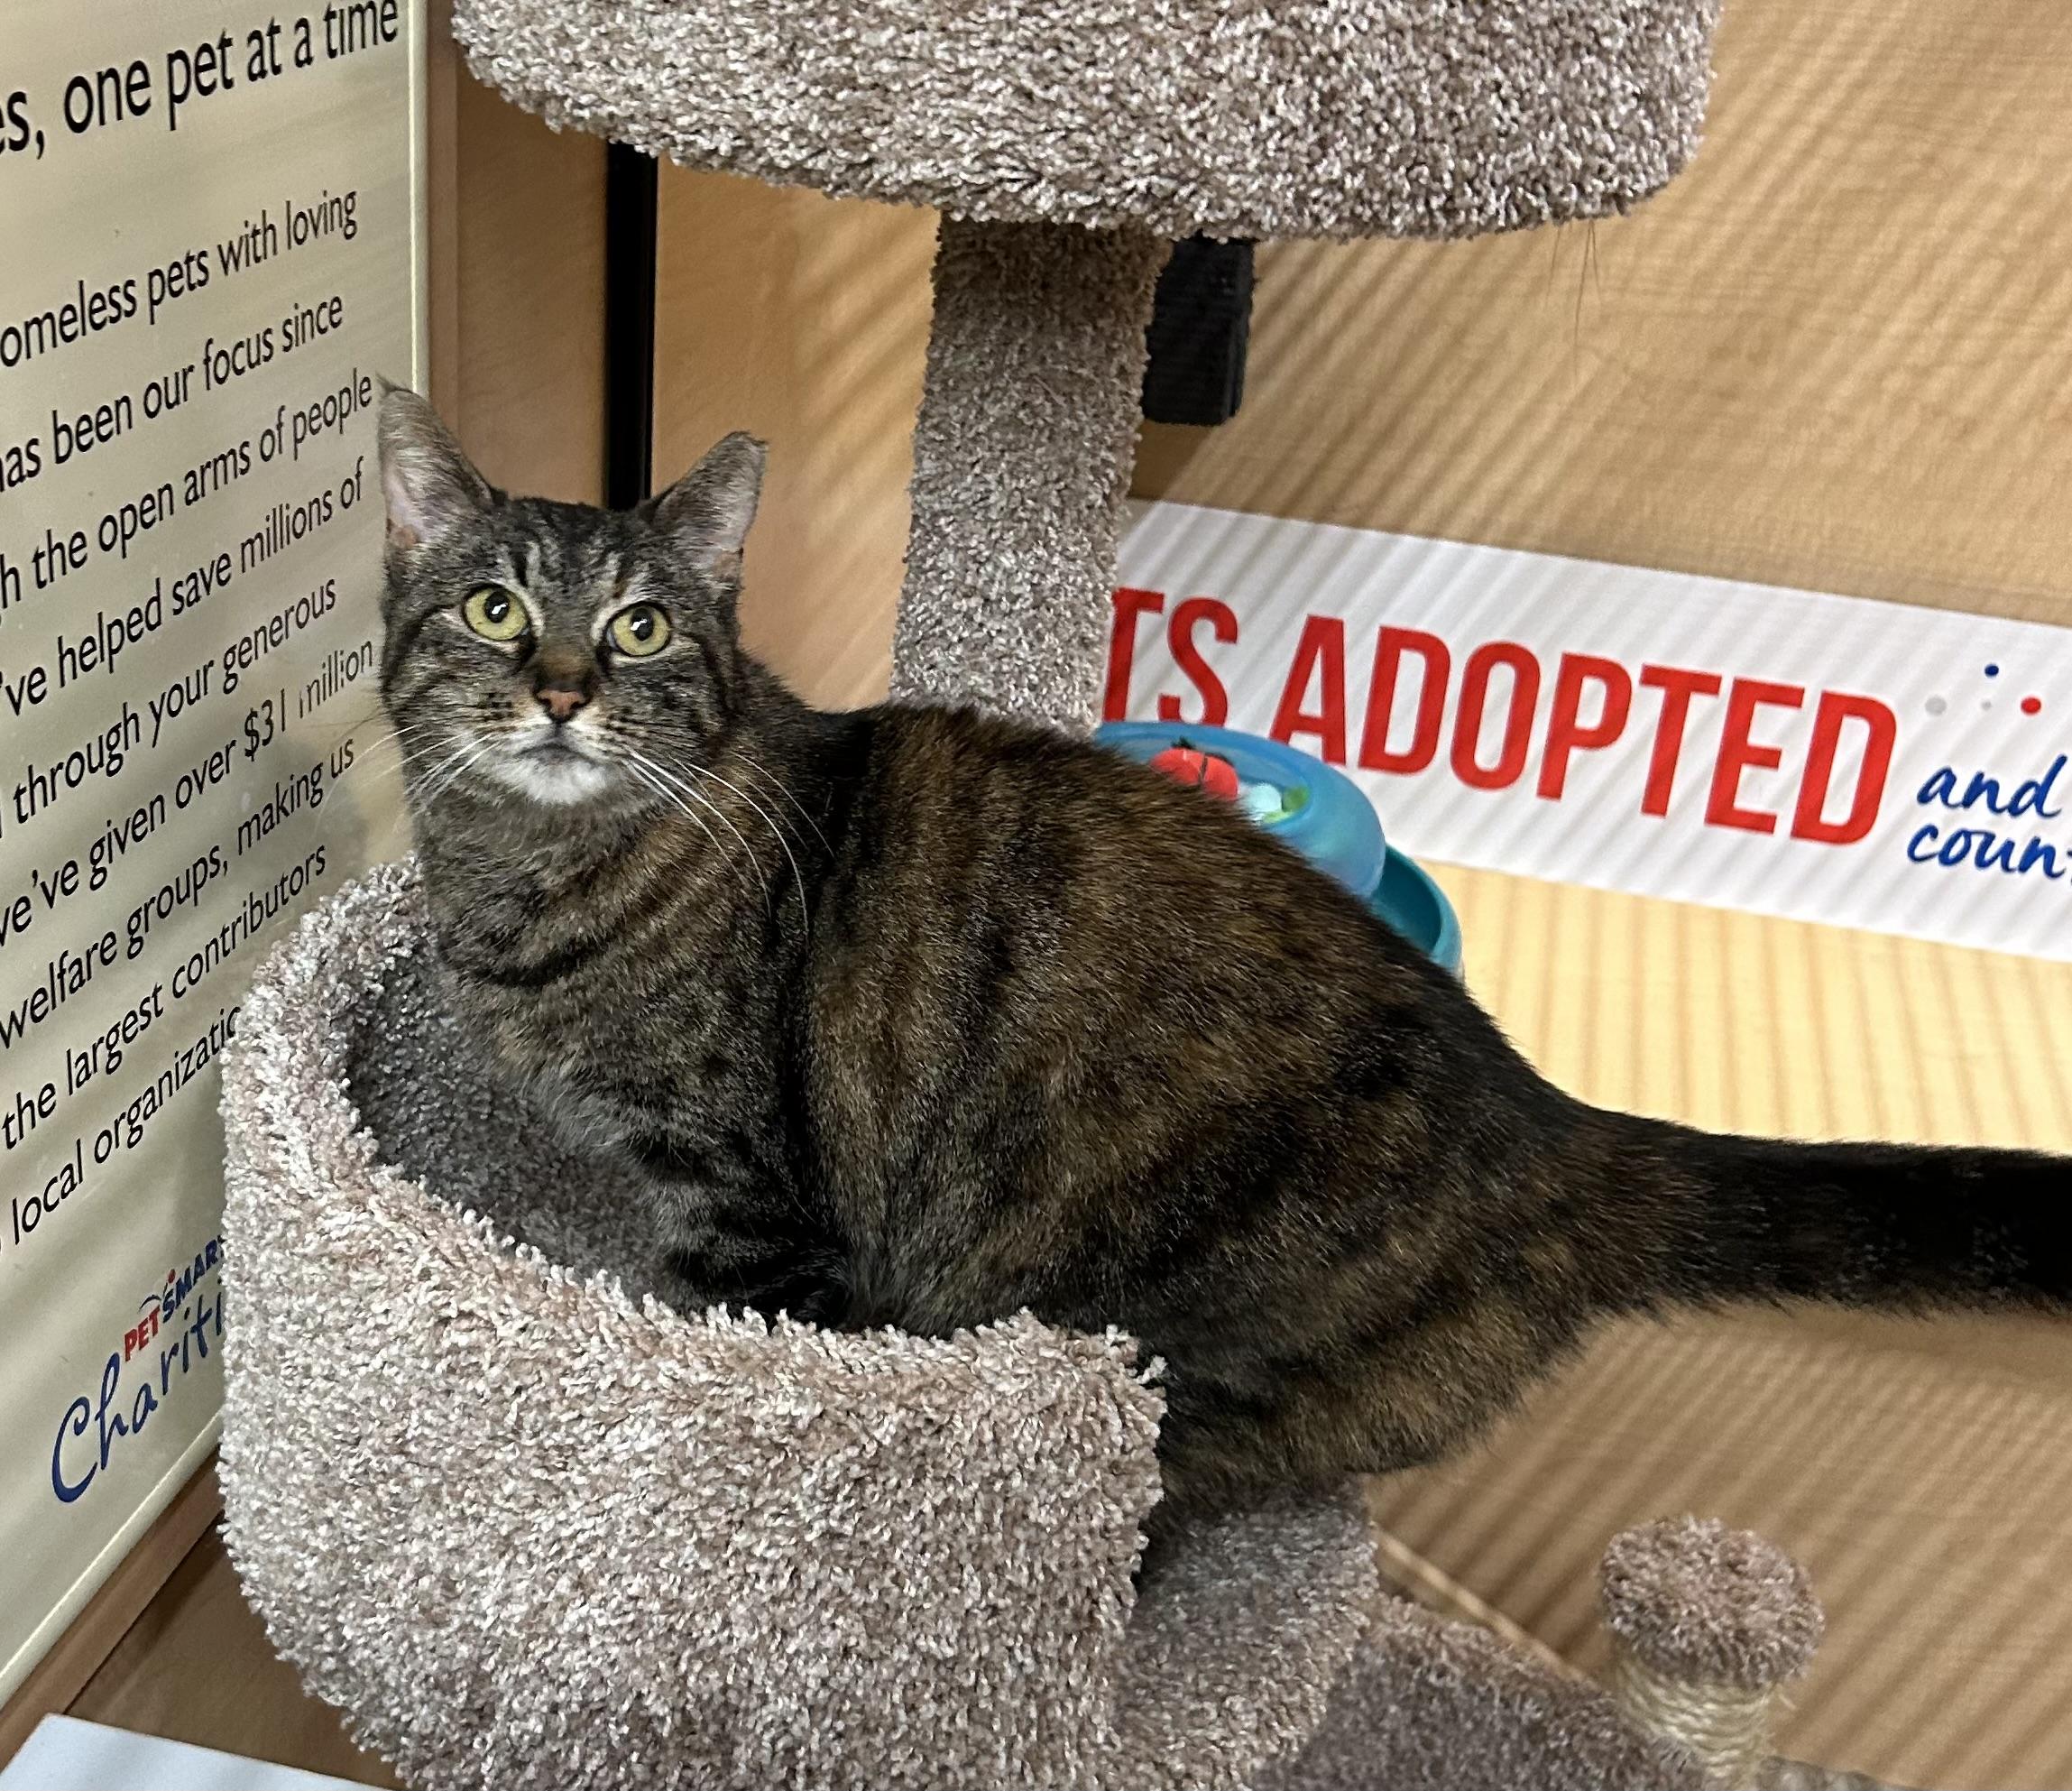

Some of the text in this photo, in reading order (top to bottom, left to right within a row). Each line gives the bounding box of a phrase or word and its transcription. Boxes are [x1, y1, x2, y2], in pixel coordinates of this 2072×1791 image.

[0, 0, 398, 160] s, one pet at a time
[147, 249, 208, 325] pets
[217, 209, 277, 276] with
[286, 189, 357, 250] loving
[32, 529, 87, 589] the
[98, 483, 174, 559] open
[184, 440, 250, 506] arms
[260, 405, 285, 462] of
[293, 367, 372, 461] people
[52, 395, 133, 465] been
[143, 365, 194, 419] our
[203, 328, 272, 391] focus
[281, 296, 343, 352] since
[58, 577, 162, 688] helped
[172, 552, 232, 615] save
[240, 490, 332, 573] millions
[340, 456, 364, 510] of
[14, 578, 336, 824] through your generous
[90, 793, 165, 891] given
[176, 739, 236, 809] over
[244, 688, 285, 762] $31
[299, 641, 373, 719] million
[1269, 614, 1897, 845] ADOPTED
[1917, 754, 2068, 817] and
[0, 738, 355, 1049] welfare groups, making us
[1907, 824, 2072, 880] coun
[3, 845, 327, 1149] the largest contributors
[12, 1138, 83, 1245] local
